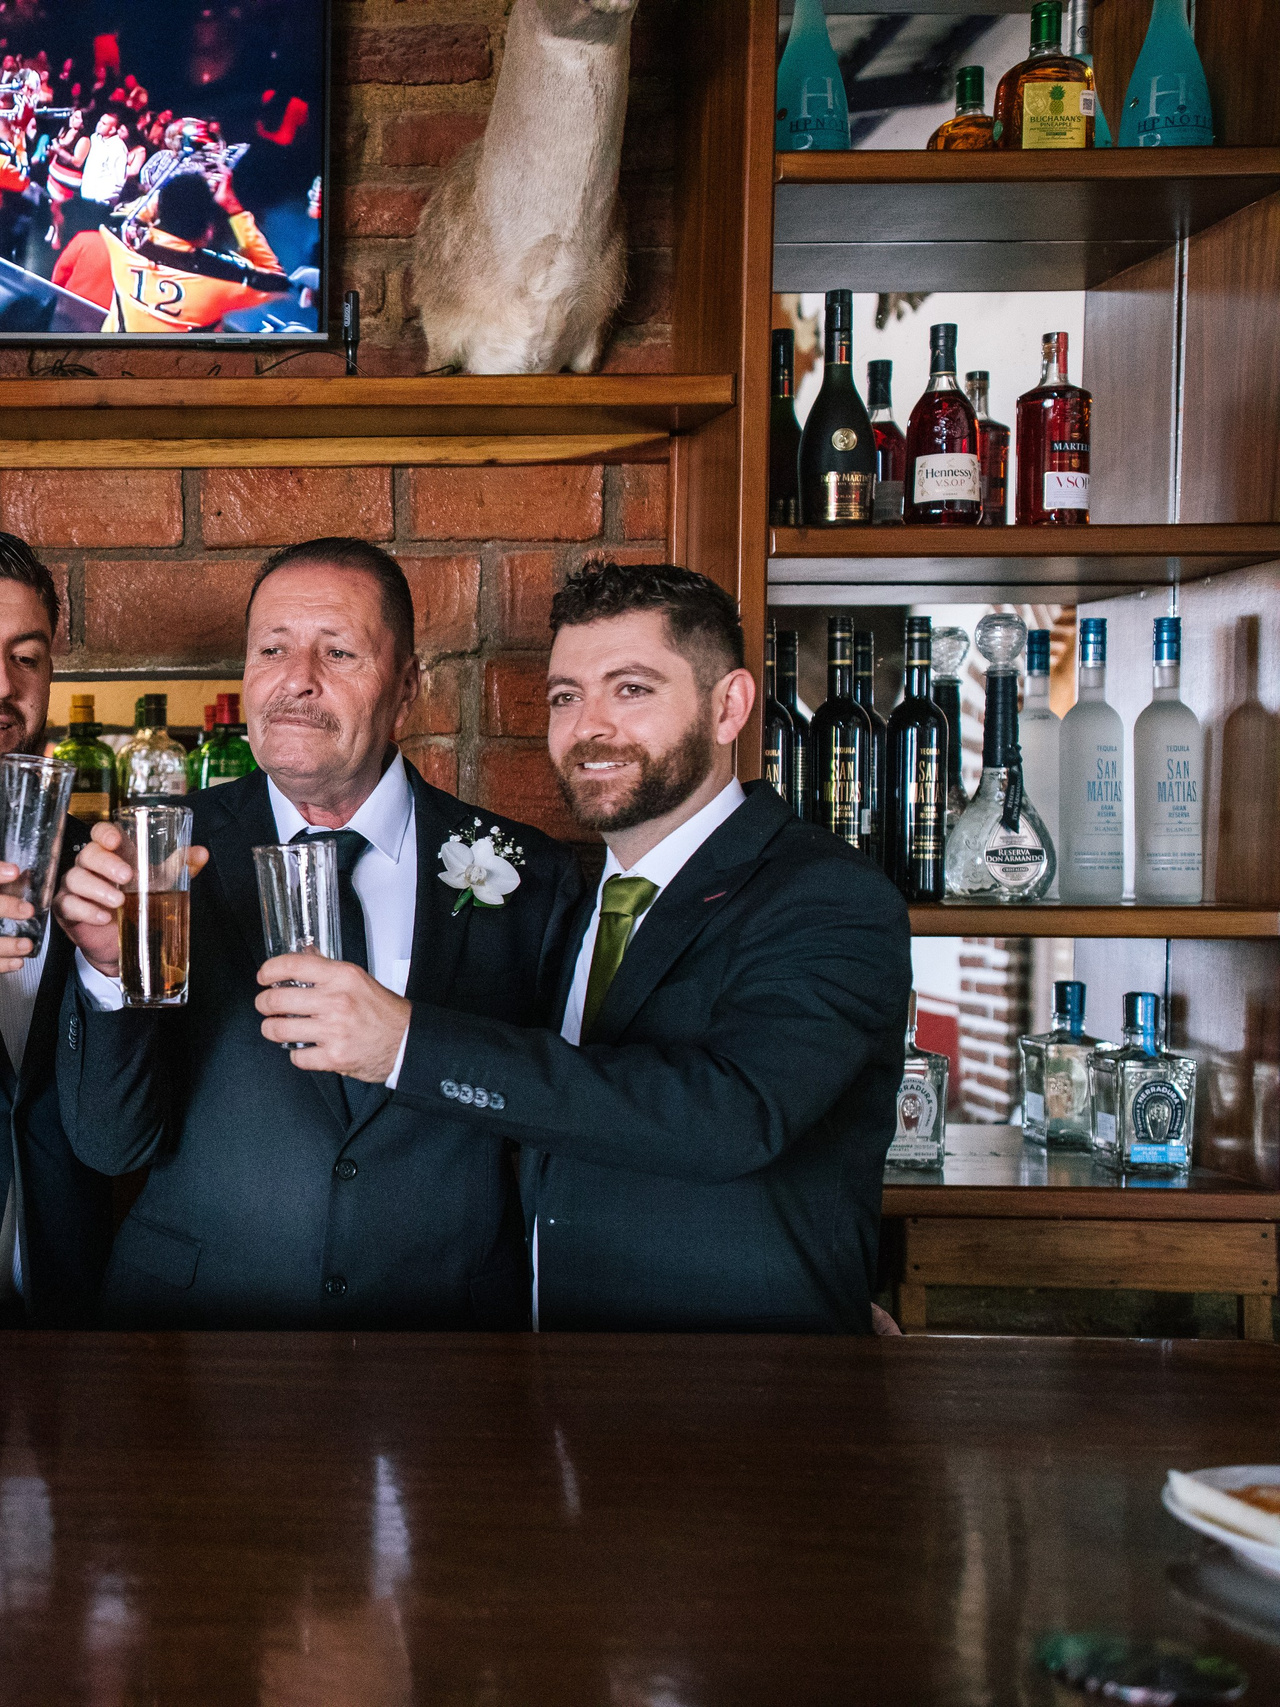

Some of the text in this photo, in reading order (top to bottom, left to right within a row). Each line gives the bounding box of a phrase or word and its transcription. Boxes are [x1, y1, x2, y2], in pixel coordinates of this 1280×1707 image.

[1030, 115, 1082, 123] BUCHANAN'S
[129, 269, 183, 317] 12
[925, 468, 972, 479] Hennessy
[919, 760, 939, 782] SAN
[1097, 758, 1117, 779] SAN
[1167, 759, 1190, 780] SAN
[1087, 780, 1122, 802] MATIAS
[1157, 781, 1197, 802] MATIAS
[1004, 854, 1044, 862] ARMANDO
[1138, 1086, 1180, 1104] HERRADURA
